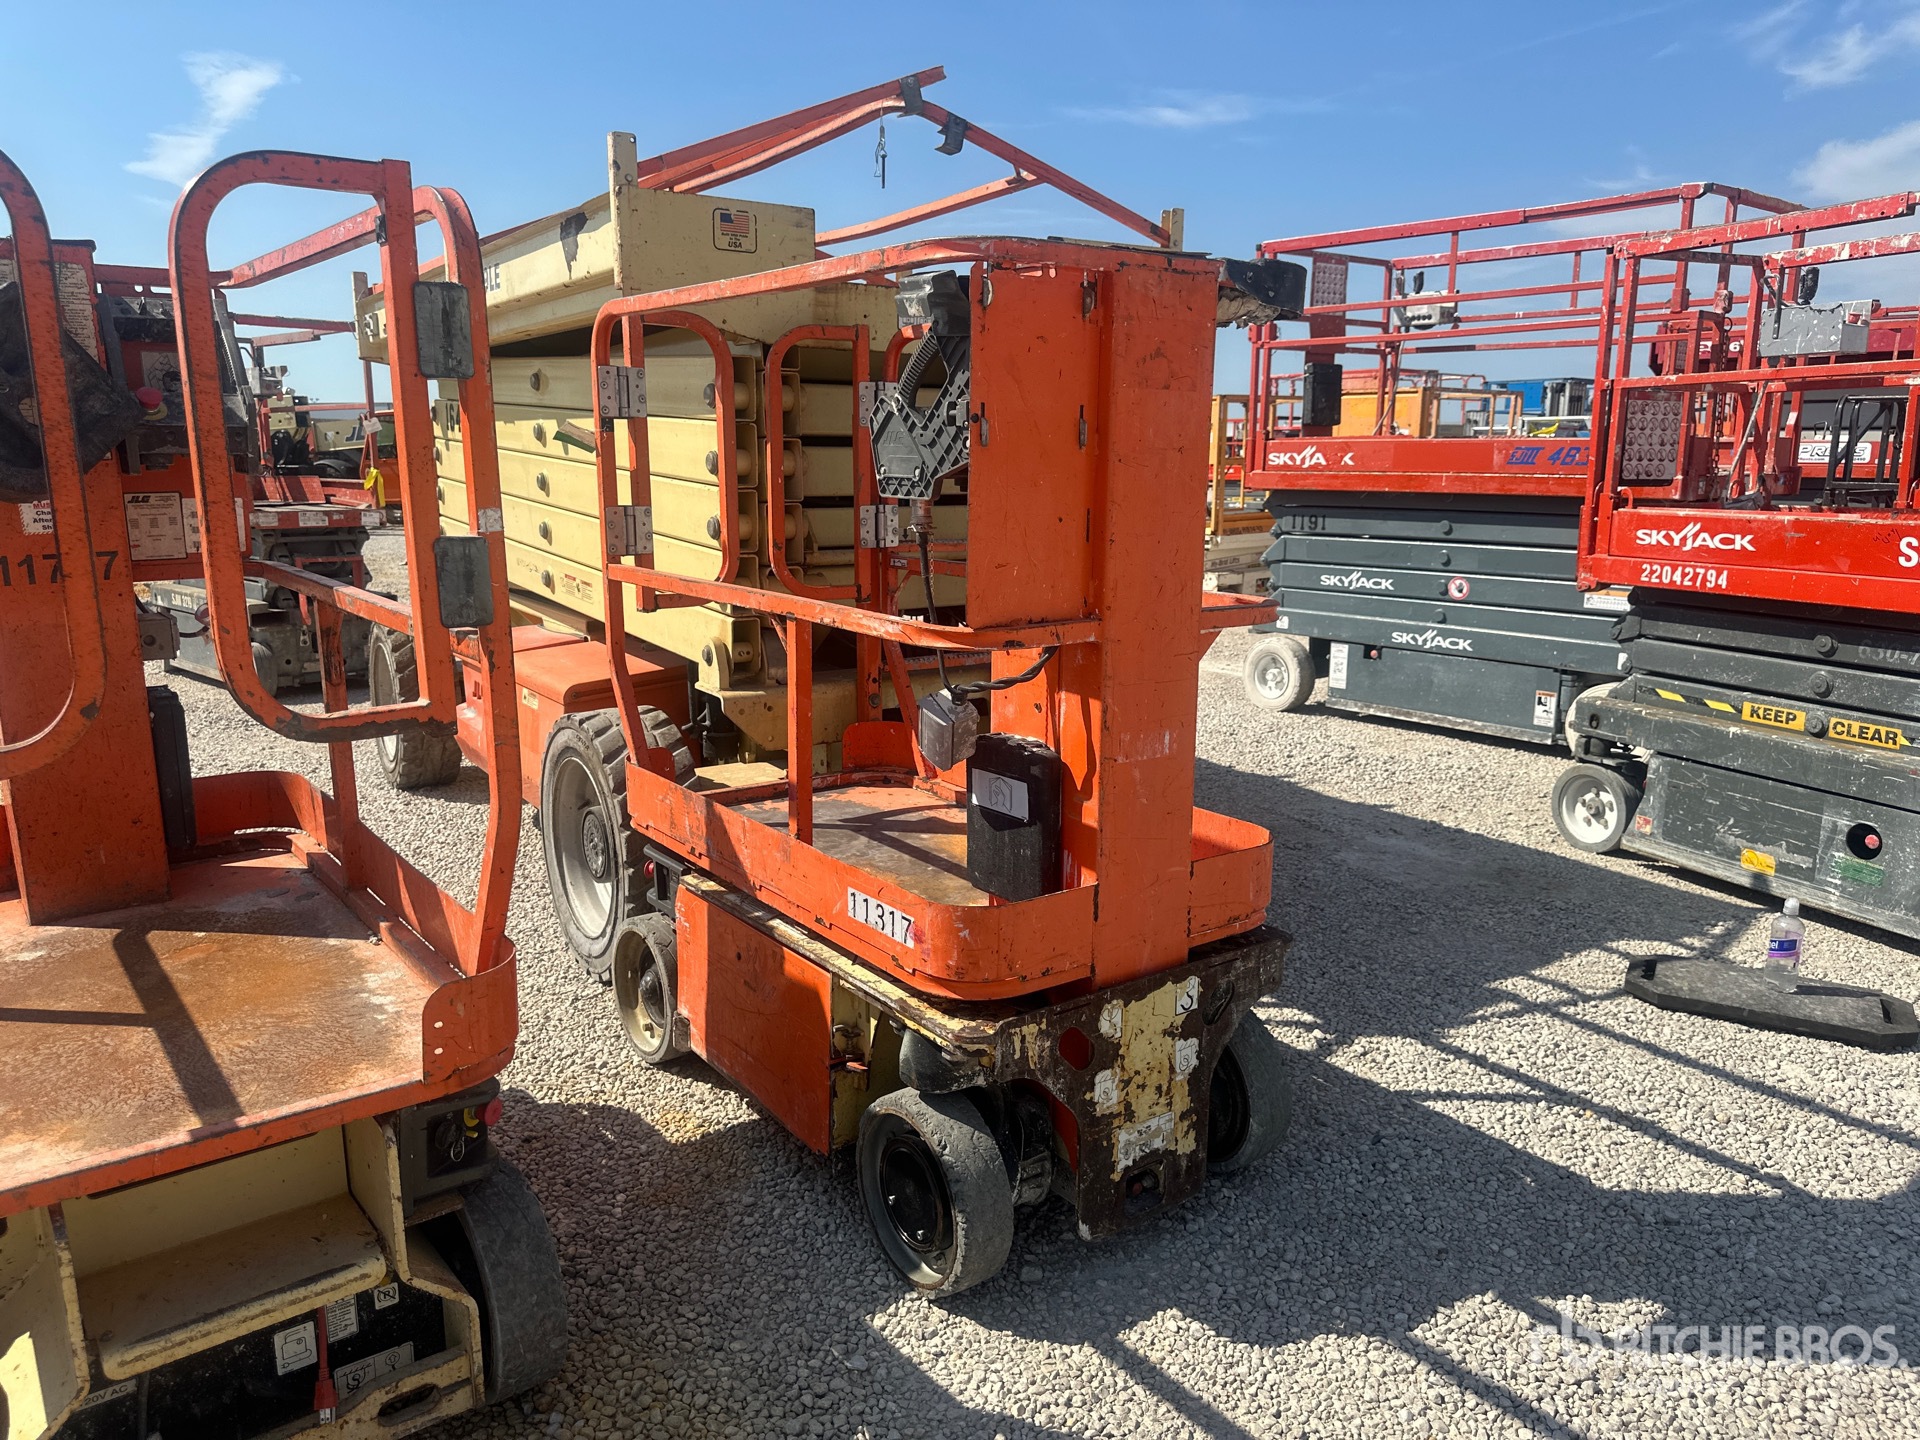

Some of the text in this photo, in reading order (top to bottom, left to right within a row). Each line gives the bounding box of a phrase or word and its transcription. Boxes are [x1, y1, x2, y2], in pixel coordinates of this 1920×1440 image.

[1268, 445, 1355, 468] SKYJAK
[128, 495, 151, 504] JLG
[1291, 514, 1327, 531] 1191
[1636, 521, 1757, 551] SKYJACK
[1898, 536, 1920, 568] S
[0, 551, 119, 587] 1177
[1320, 571, 1394, 591] SKYJACK
[1640, 563, 1728, 589] 22042794
[1391, 629, 1474, 651] SKYJACK
[1749, 704, 1898, 746] KEEP CLEAR
[850, 891, 912, 945] 11317
[111, 1384, 128, 1396] AC
